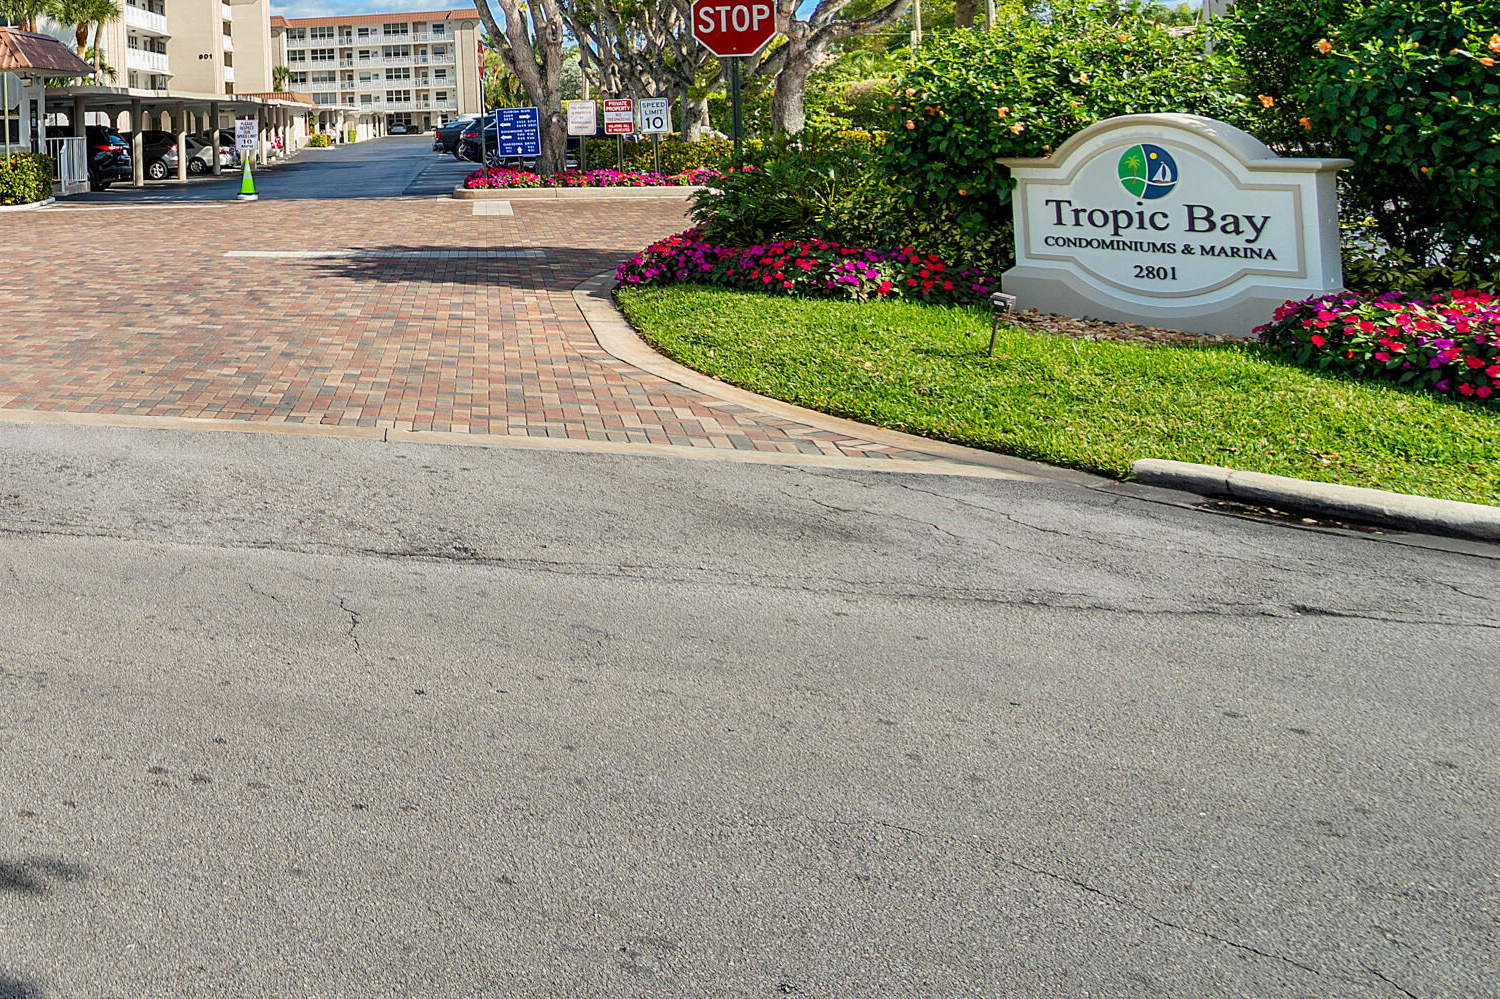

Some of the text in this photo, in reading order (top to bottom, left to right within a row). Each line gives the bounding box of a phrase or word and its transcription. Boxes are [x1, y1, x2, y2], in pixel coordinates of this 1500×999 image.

[698, 4, 770, 34] STOP
[646, 116, 663, 129] 10
[1045, 199, 1271, 244] Tropic Bay
[1044, 236, 1278, 261] CONDOMINIUMS & MARINA
[1133, 264, 1178, 280] 2801
